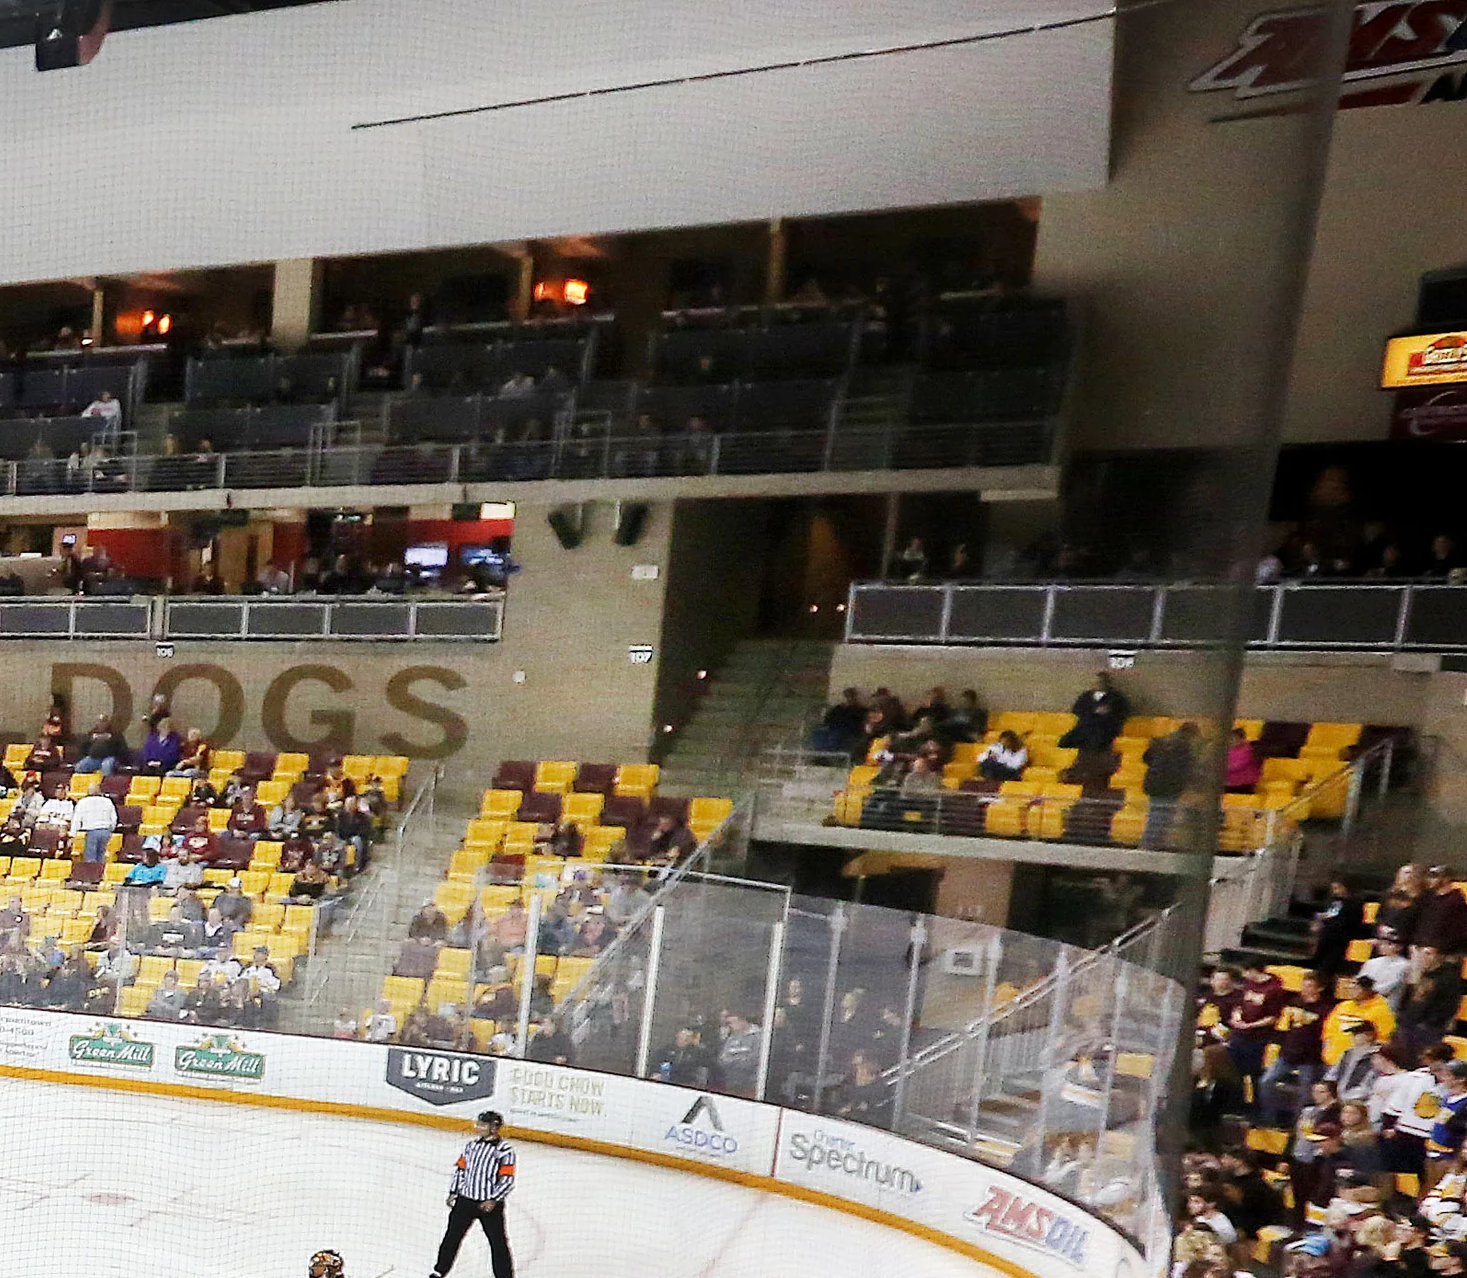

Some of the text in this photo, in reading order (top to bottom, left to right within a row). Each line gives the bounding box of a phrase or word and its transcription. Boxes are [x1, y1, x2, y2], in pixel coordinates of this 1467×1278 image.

[74, 1041, 148, 1062] Green Mill
[179, 1051, 259, 1073] Green Mill
[402, 1053, 480, 1086] LYRIC
[512, 1088, 566, 1109] STARTS
[665, 1124, 738, 1154] ASDCO
[789, 1133, 918, 1193] Spectrum
[971, 1185, 1090, 1264] AMSOIL
